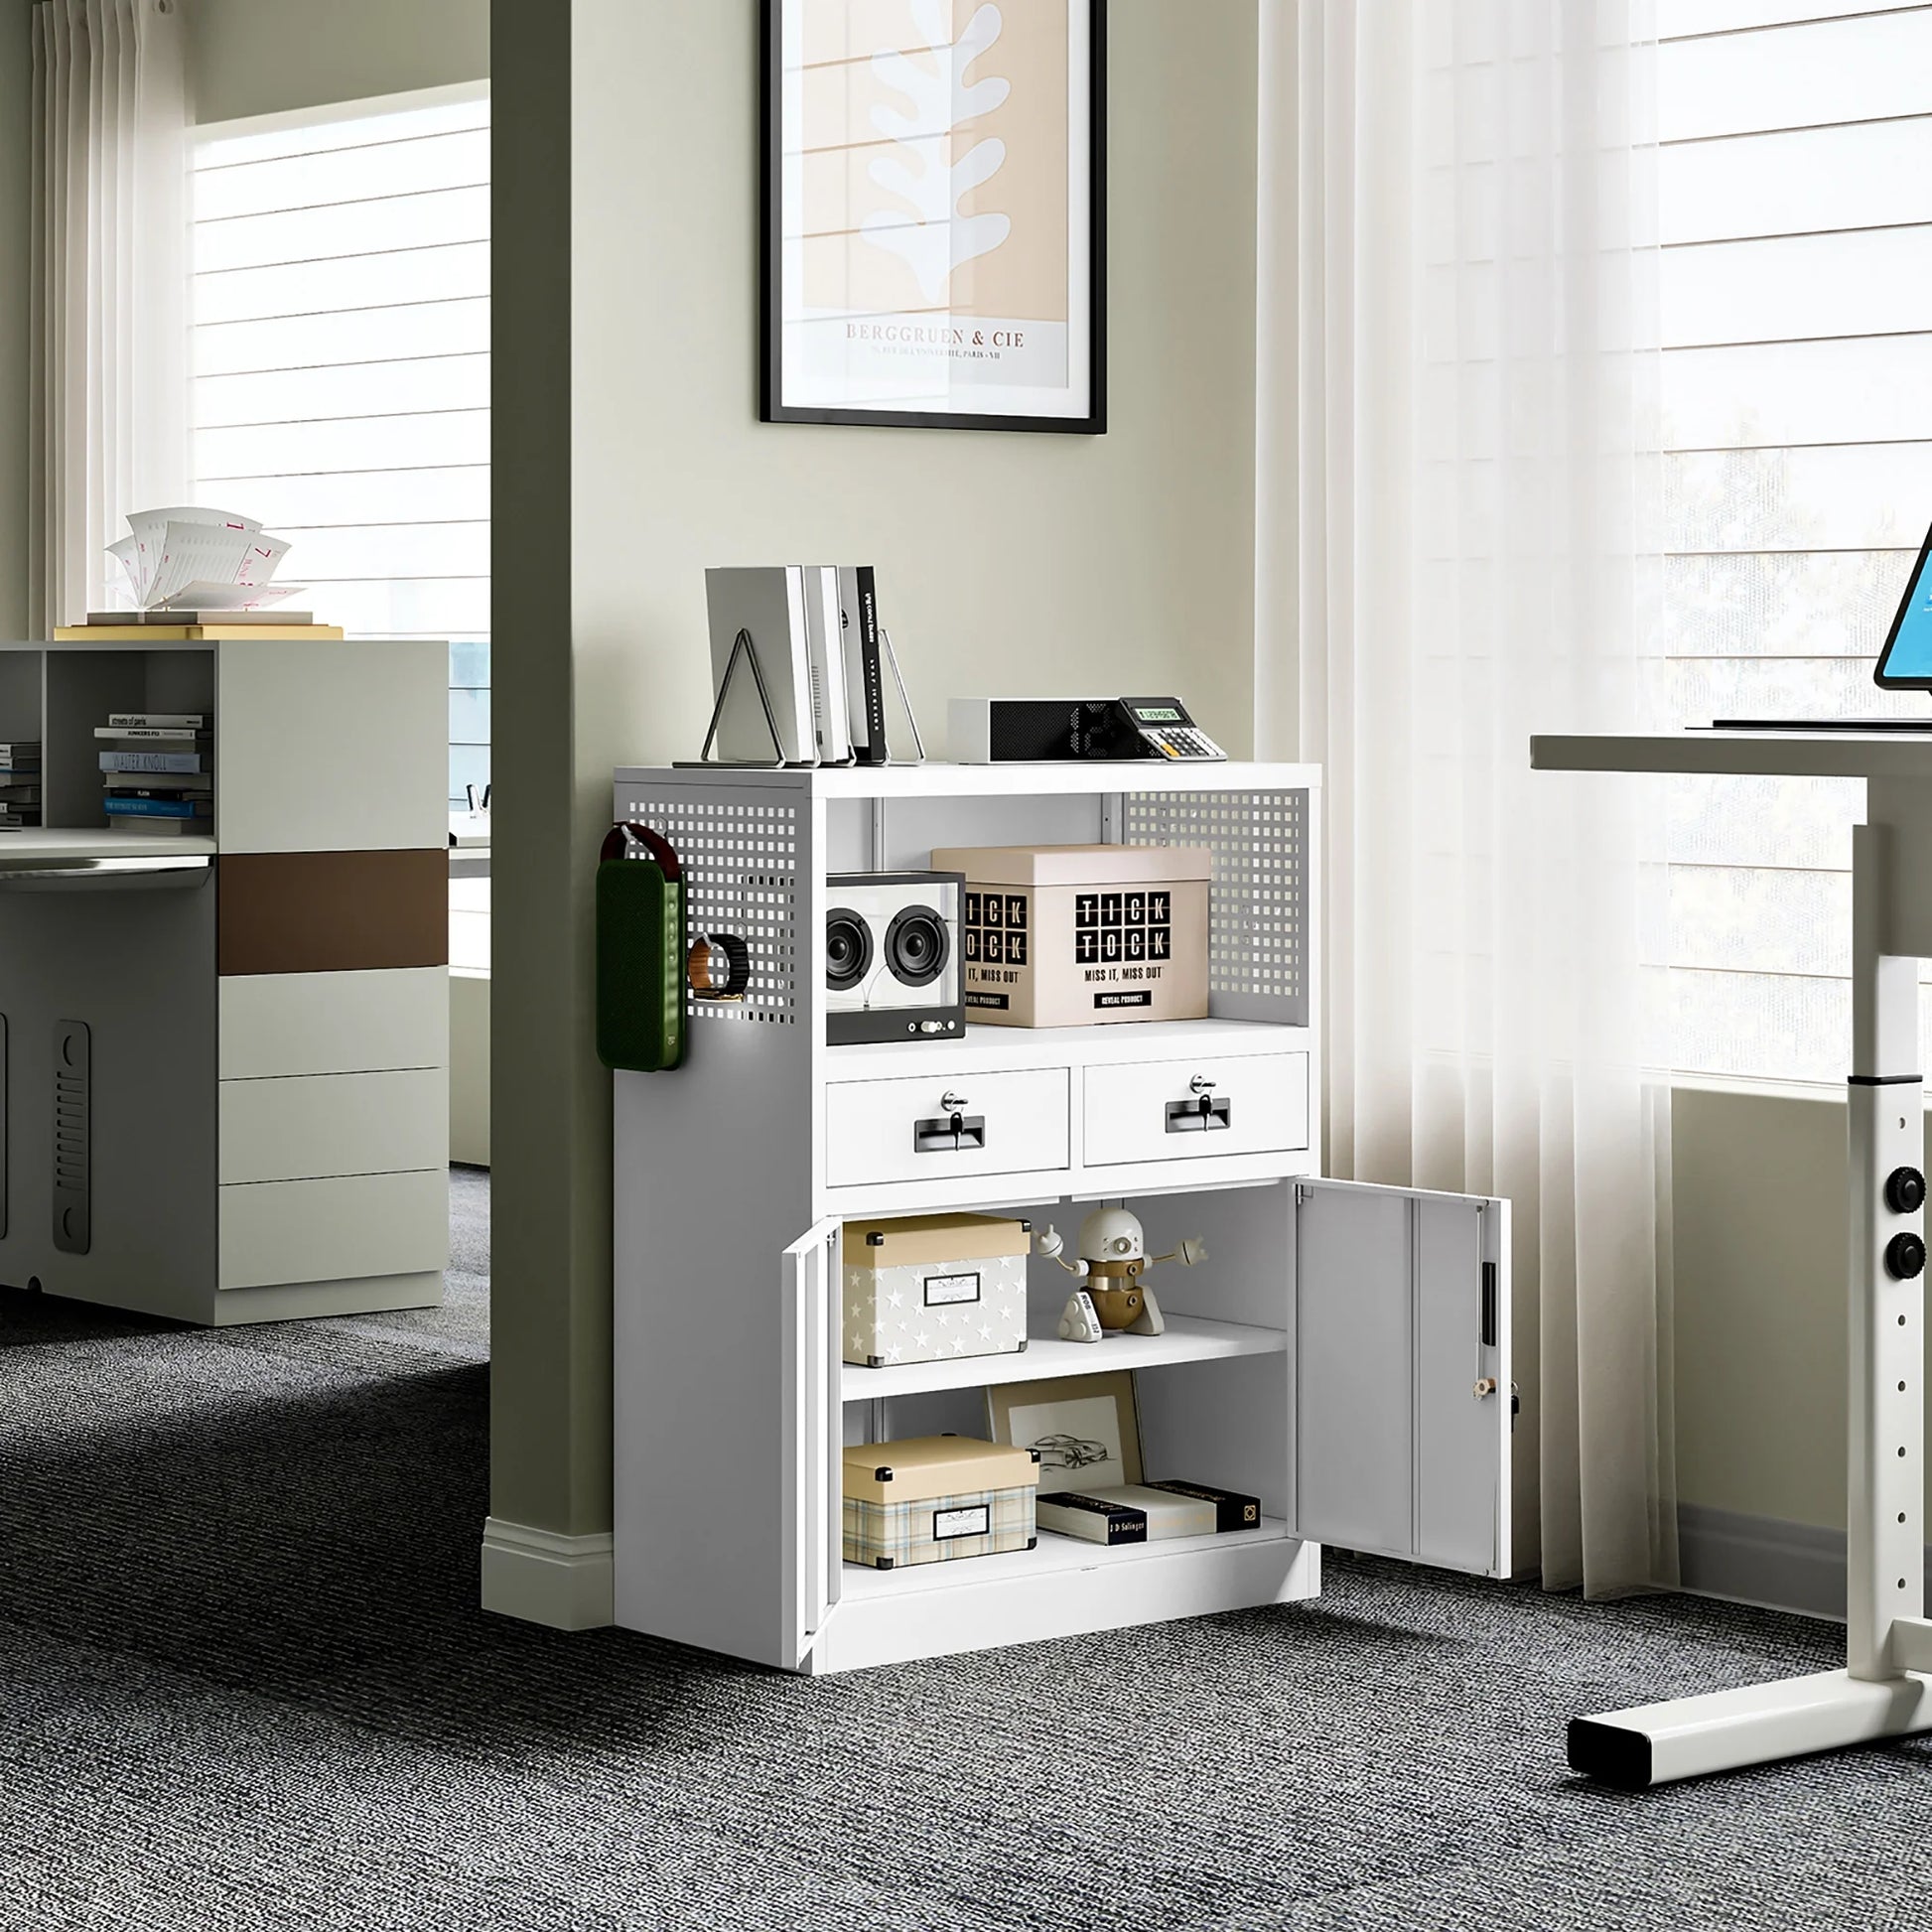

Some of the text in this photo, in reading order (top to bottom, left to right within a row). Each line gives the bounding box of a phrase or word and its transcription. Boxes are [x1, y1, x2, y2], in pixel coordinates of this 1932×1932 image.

[846, 324, 1024, 347] BERGGRUEN & CIE
[113, 754, 167, 771] WALTER KNOLL
[969, 898, 1021, 923] ICK
[1082, 897, 1165, 922] TICK
[967, 933, 1021, 959] OCK
[1082, 932, 1165, 958] TOCK
[981, 969, 1001, 983] MISS
[1003, 970, 1019, 984] OUT
[1084, 969, 1106, 982] MISS
[1122, 967, 1144, 980] MISS
[1146, 966, 1162, 979] OUT
